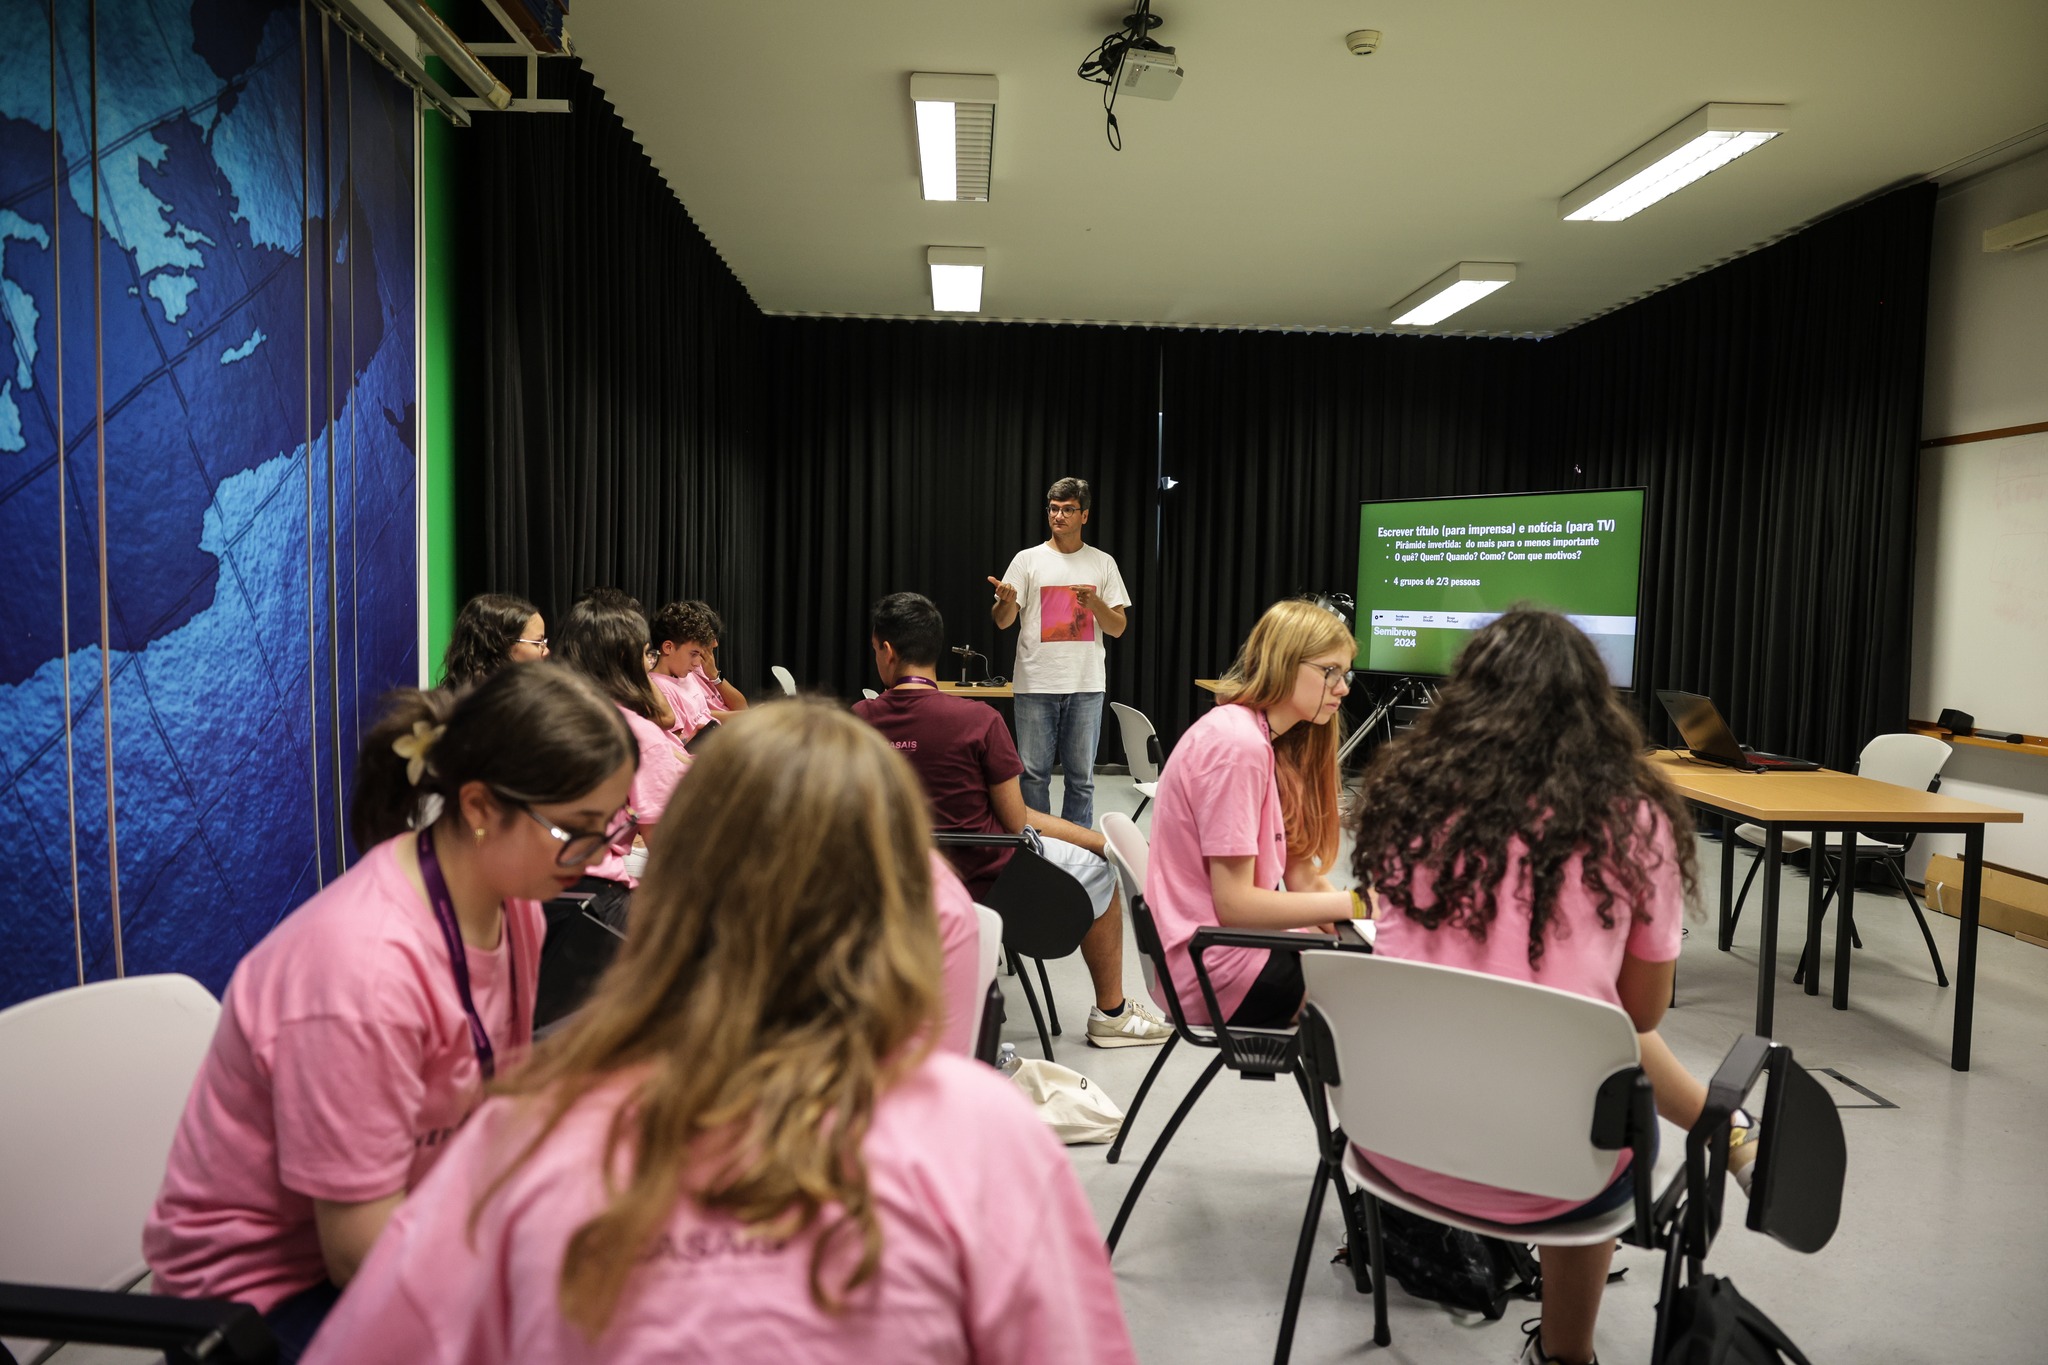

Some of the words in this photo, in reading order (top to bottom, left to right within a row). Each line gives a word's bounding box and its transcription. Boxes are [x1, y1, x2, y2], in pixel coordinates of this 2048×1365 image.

[1378, 526, 1414, 537] Escrever
[1416, 525, 1439, 536] título
[1442, 525, 1466, 537] (para
[1468, 523, 1516, 536] imprensa)
[1519, 525, 1525, 533] e
[1528, 521, 1562, 533] notícia
[1566, 520, 1594, 533] (para
[1597, 519, 1615, 532] TV)
[1395, 540, 1426, 549] Pirâmide
[1428, 539, 1461, 549] invertida:
[1466, 539, 1475, 548] do
[1477, 539, 1495, 548] mais
[1497, 540, 1515, 549] para
[1524, 539, 1551, 547] menos
[1553, 537, 1599, 548] importante
[1394, 553, 1400, 561] O
[1402, 553, 1418, 562] quê?
[1420, 552, 1444, 562] Quem?
[1446, 551, 1478, 562] Quando?
[1480, 551, 1506, 561] Como?
[1508, 551, 1525, 560] Com
[1527, 553, 1542, 561] que
[1545, 550, 1581, 560] motivos?
[1393, 577, 1398, 585] 4
[1400, 578, 1424, 587] grupos
[1425, 577, 1434, 585] de
[1436, 576, 1449, 586] 2/3
[1451, 578, 1480, 587] pessoas
[1374, 627, 1416, 637] Semibreve
[1394, 638, 1416, 647] 2024
[889, 741, 917, 749] ASAIS
